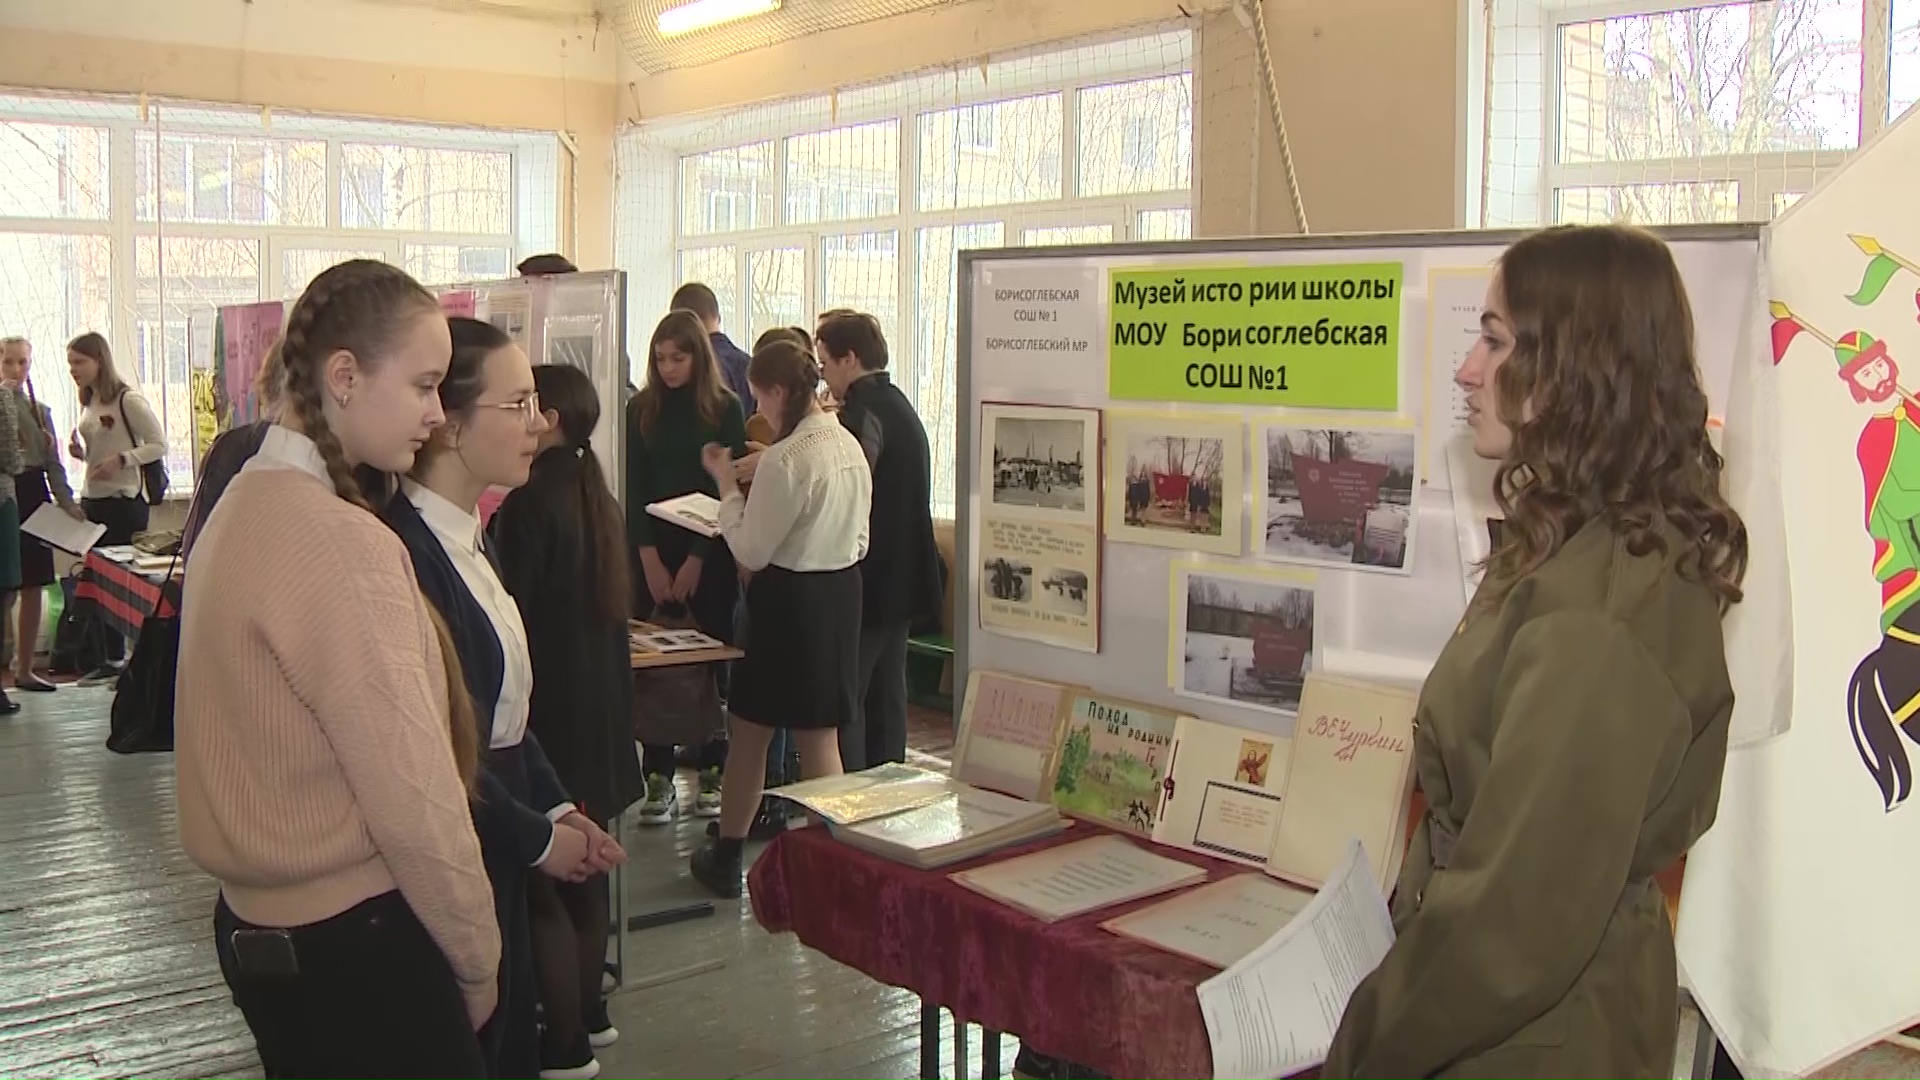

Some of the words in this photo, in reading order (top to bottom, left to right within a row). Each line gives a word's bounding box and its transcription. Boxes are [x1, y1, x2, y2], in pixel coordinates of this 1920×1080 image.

[995, 289, 1080, 301] БОРИСОГЛЕБСКАЯ
[1115, 278, 1186, 310] Музей
[1301, 278, 1395, 300] школы
[1014, 310, 1037, 322] СОШ
[1039, 310, 1050, 321] №
[1053, 310, 1058, 321] 1
[1115, 322, 1168, 346] МОУ
[986, 337, 1070, 350] БОРИСОГЛЕБСКИЙ
[1072, 341, 1088, 351] МР
[1186, 363, 1243, 388] СОШ
[1248, 364, 1288, 390] №1
